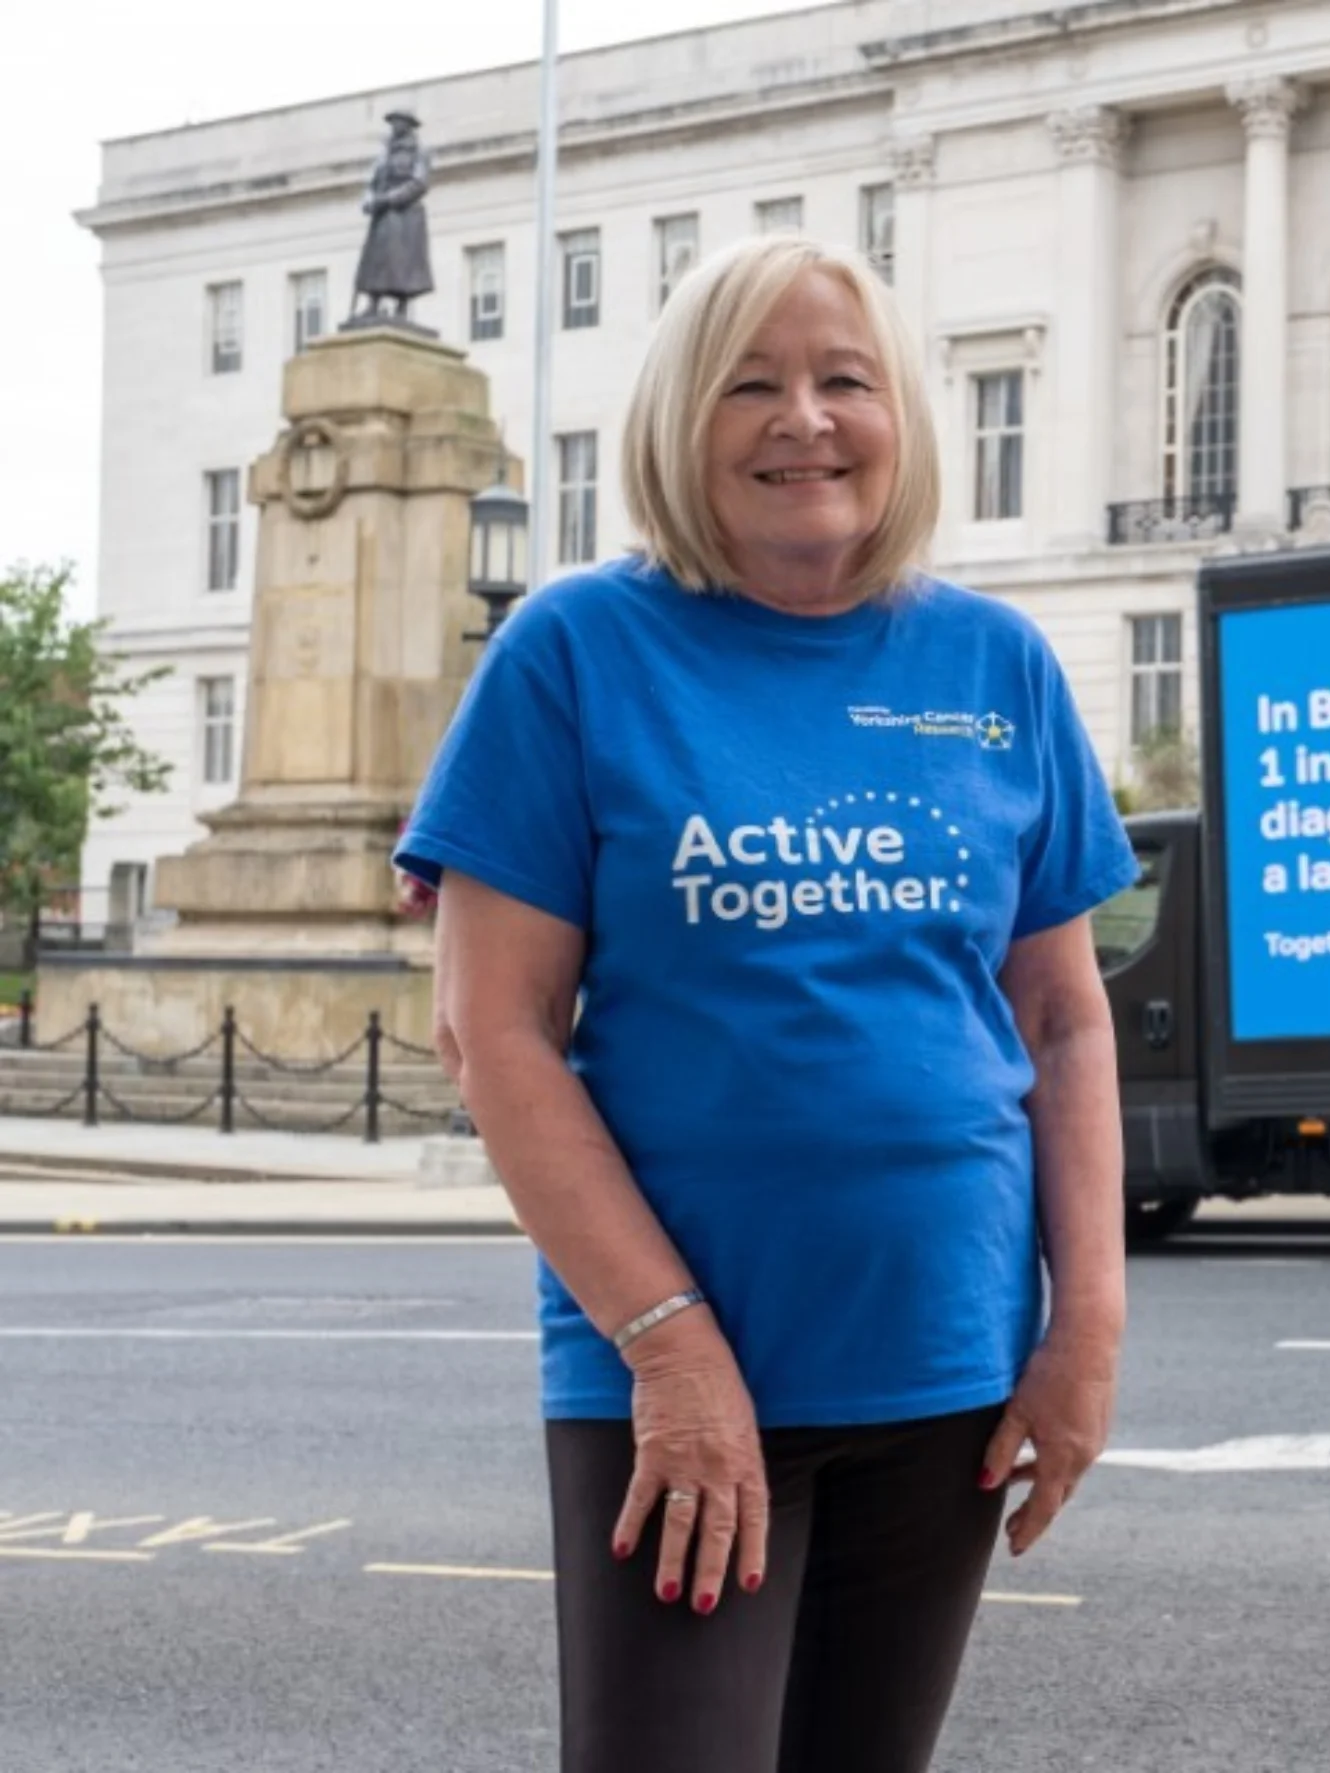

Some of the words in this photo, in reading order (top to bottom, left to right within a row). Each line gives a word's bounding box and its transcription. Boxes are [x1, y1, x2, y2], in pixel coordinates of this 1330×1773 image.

[1257, 695, 1298, 734] In
[1259, 748, 1285, 787] 1
[672, 814, 904, 870] Active
[1262, 863, 1288, 894] a
